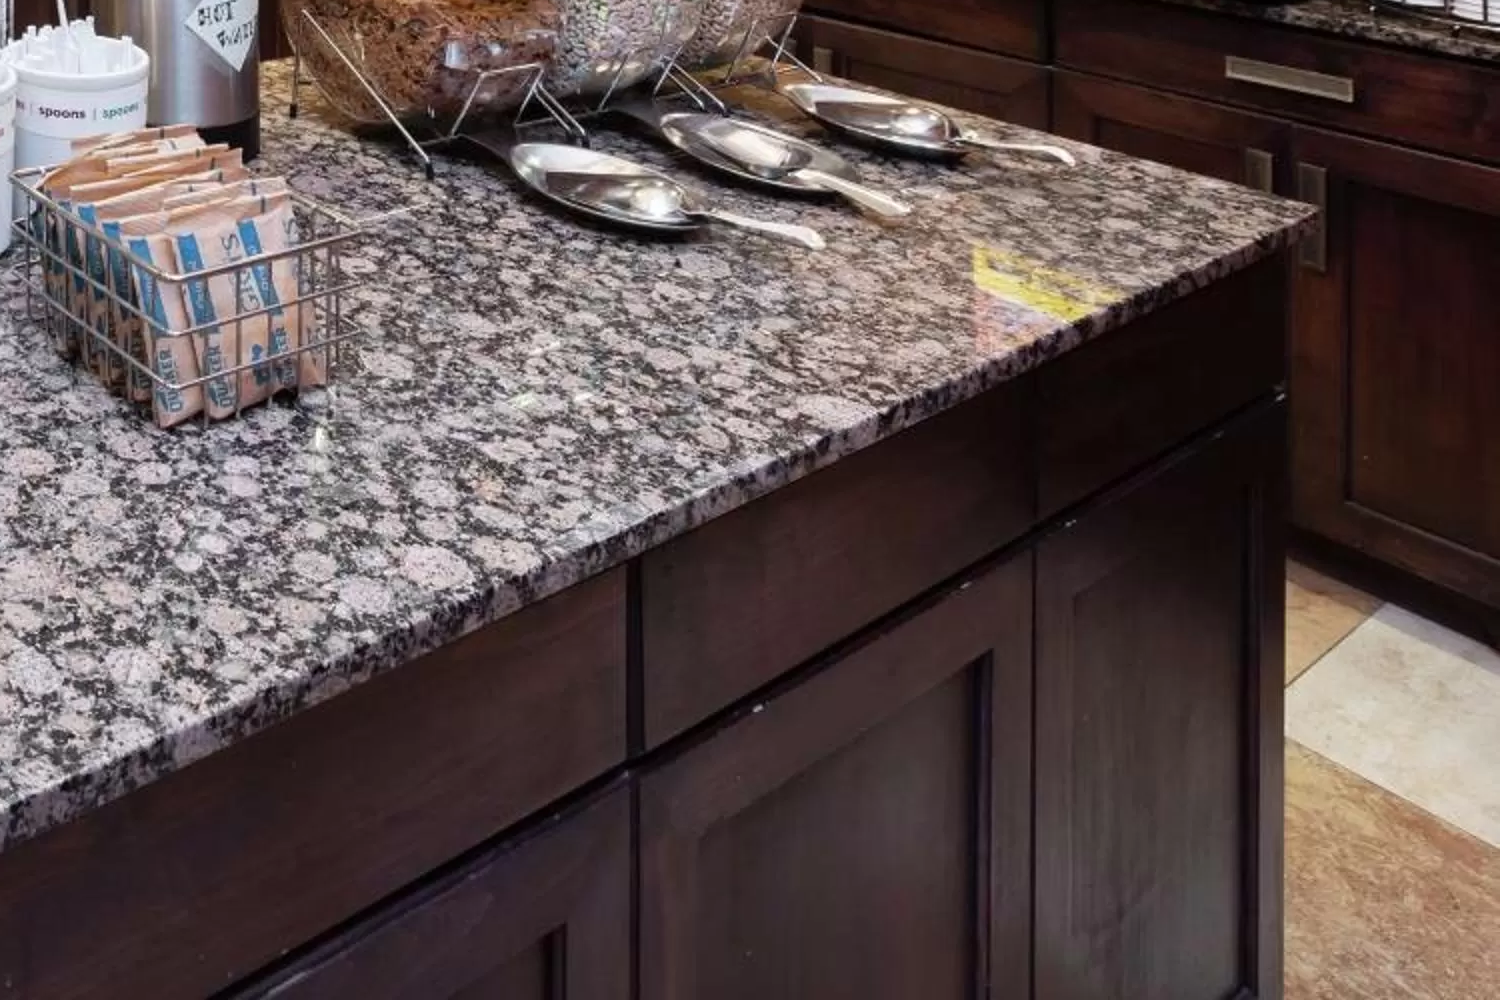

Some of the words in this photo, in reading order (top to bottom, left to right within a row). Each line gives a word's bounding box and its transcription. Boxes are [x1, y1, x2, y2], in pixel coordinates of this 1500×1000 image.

[38, 106, 87, 120] spoons
[220, 232, 261, 312] GRTS
[158, 348, 184, 413] QUAKER
